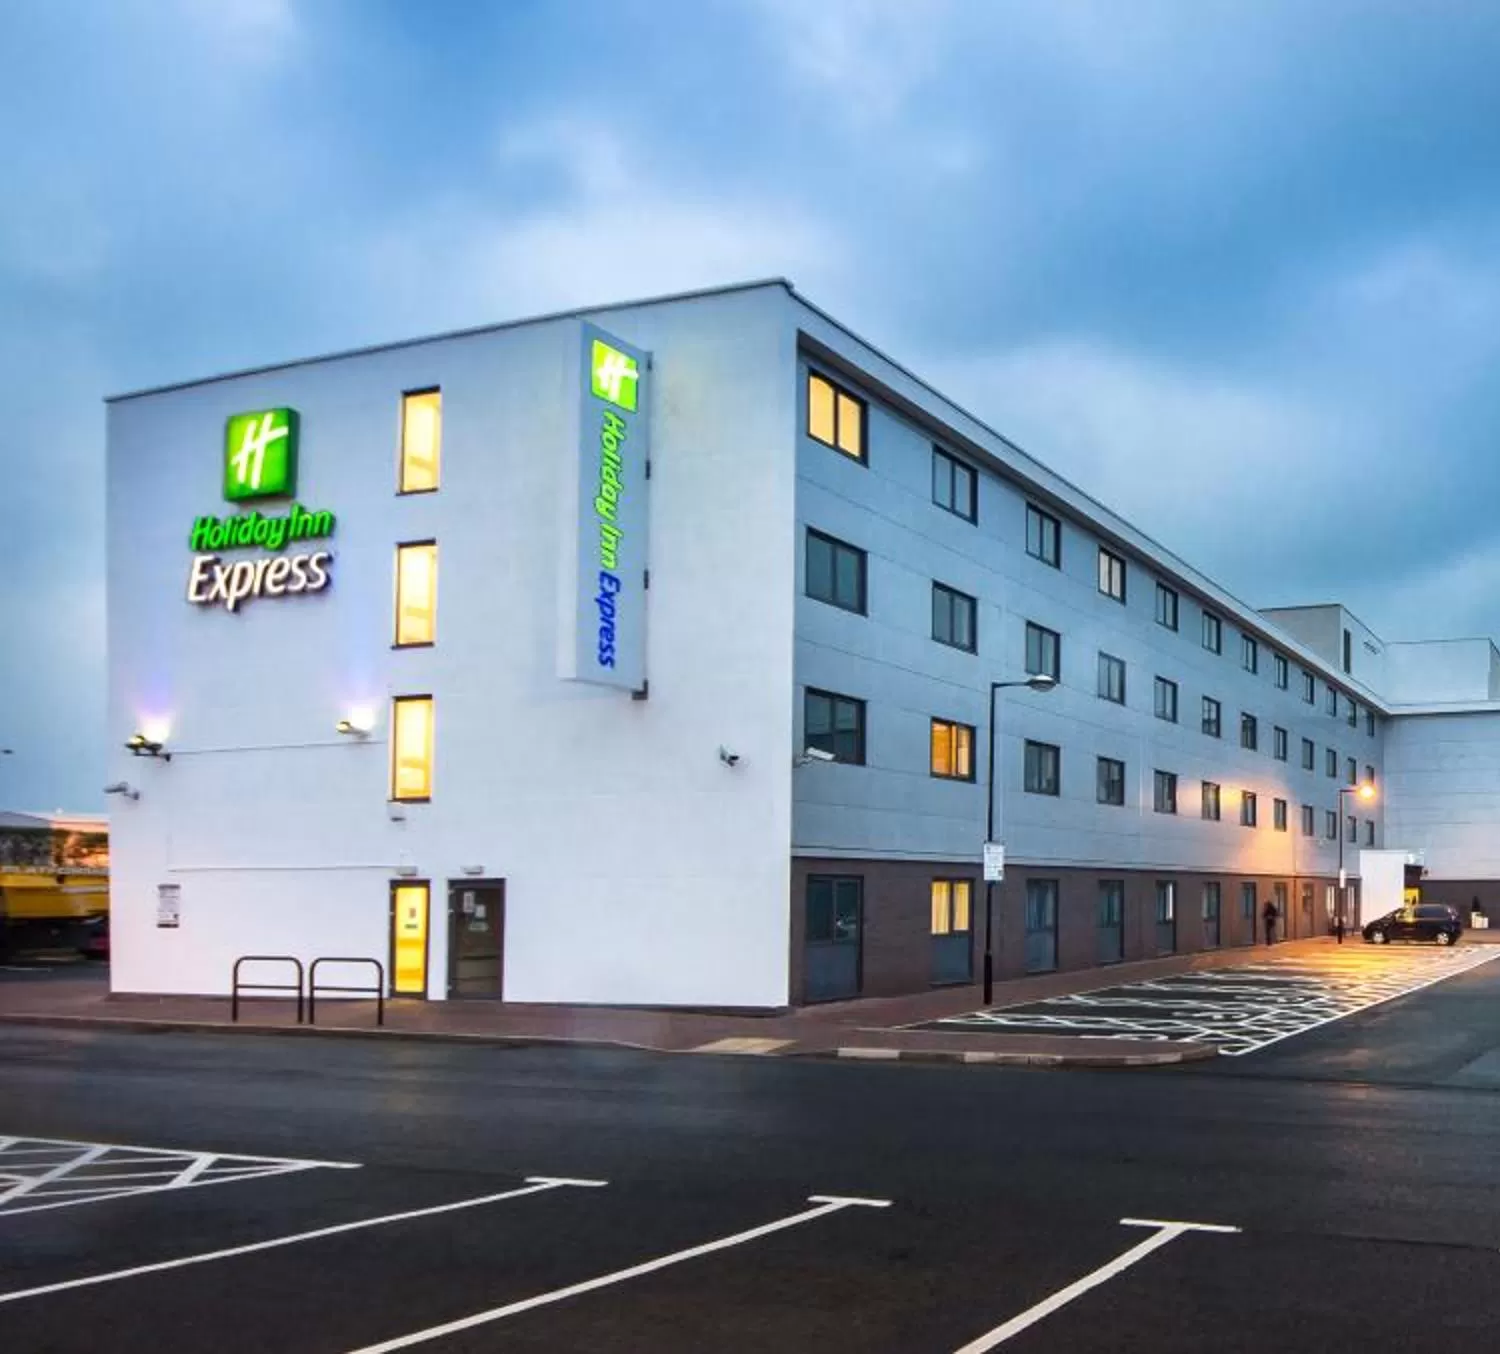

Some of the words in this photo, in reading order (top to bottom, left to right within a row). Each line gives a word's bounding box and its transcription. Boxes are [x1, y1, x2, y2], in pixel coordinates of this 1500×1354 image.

[594, 409, 627, 521] Holiday
[190, 512, 288, 551] Holiday
[289, 503, 335, 540] Inn
[599, 522, 624, 570] Inn
[188, 552, 330, 611] Express
[595, 570, 621, 668] Express
